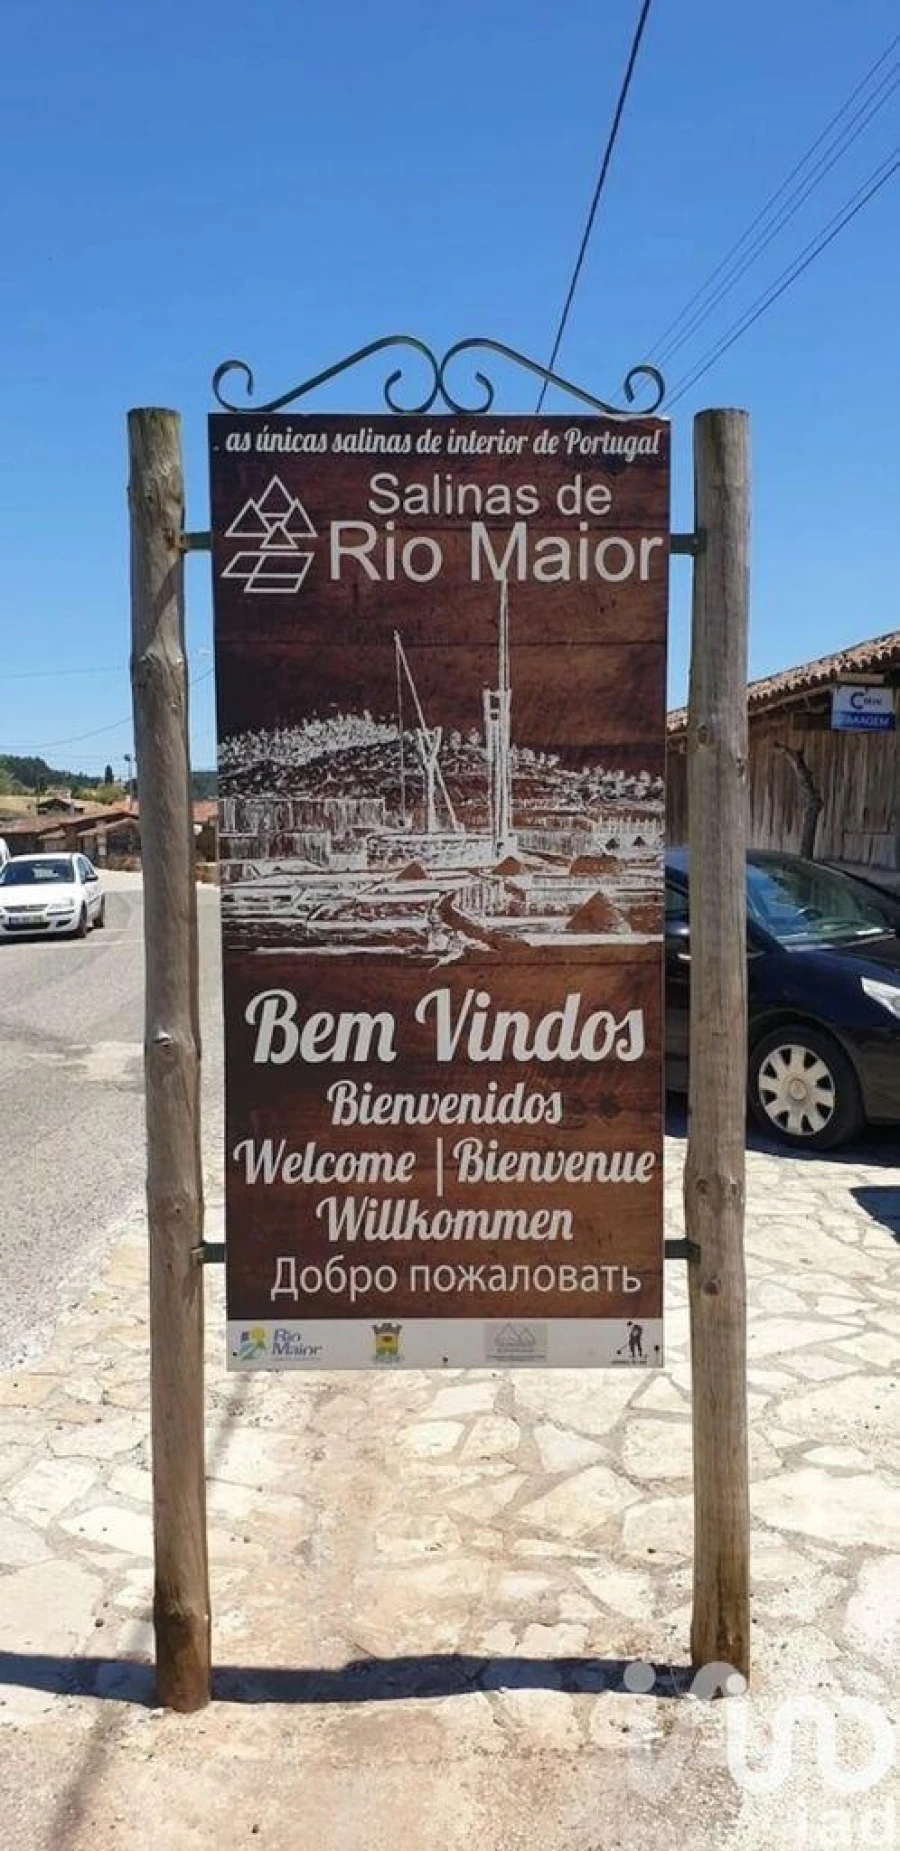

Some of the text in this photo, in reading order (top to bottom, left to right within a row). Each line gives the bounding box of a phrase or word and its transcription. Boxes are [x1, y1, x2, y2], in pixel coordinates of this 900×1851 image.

[225, 424, 662, 463] as únicas salinas de interior de Portugal
[368, 472, 612, 516] Salinas de
[330, 520, 664, 583] Rio Maior
[245, 988, 646, 1064] Bem Vindos
[326, 1080, 563, 1126] Bienvenidos
[232, 1138, 416, 1185] Welcome
[452, 1137, 656, 1183] Bienvenue
[315, 1194, 574, 1241] Willkommen
[270, 1254, 642, 1302] Добро пожаловать
